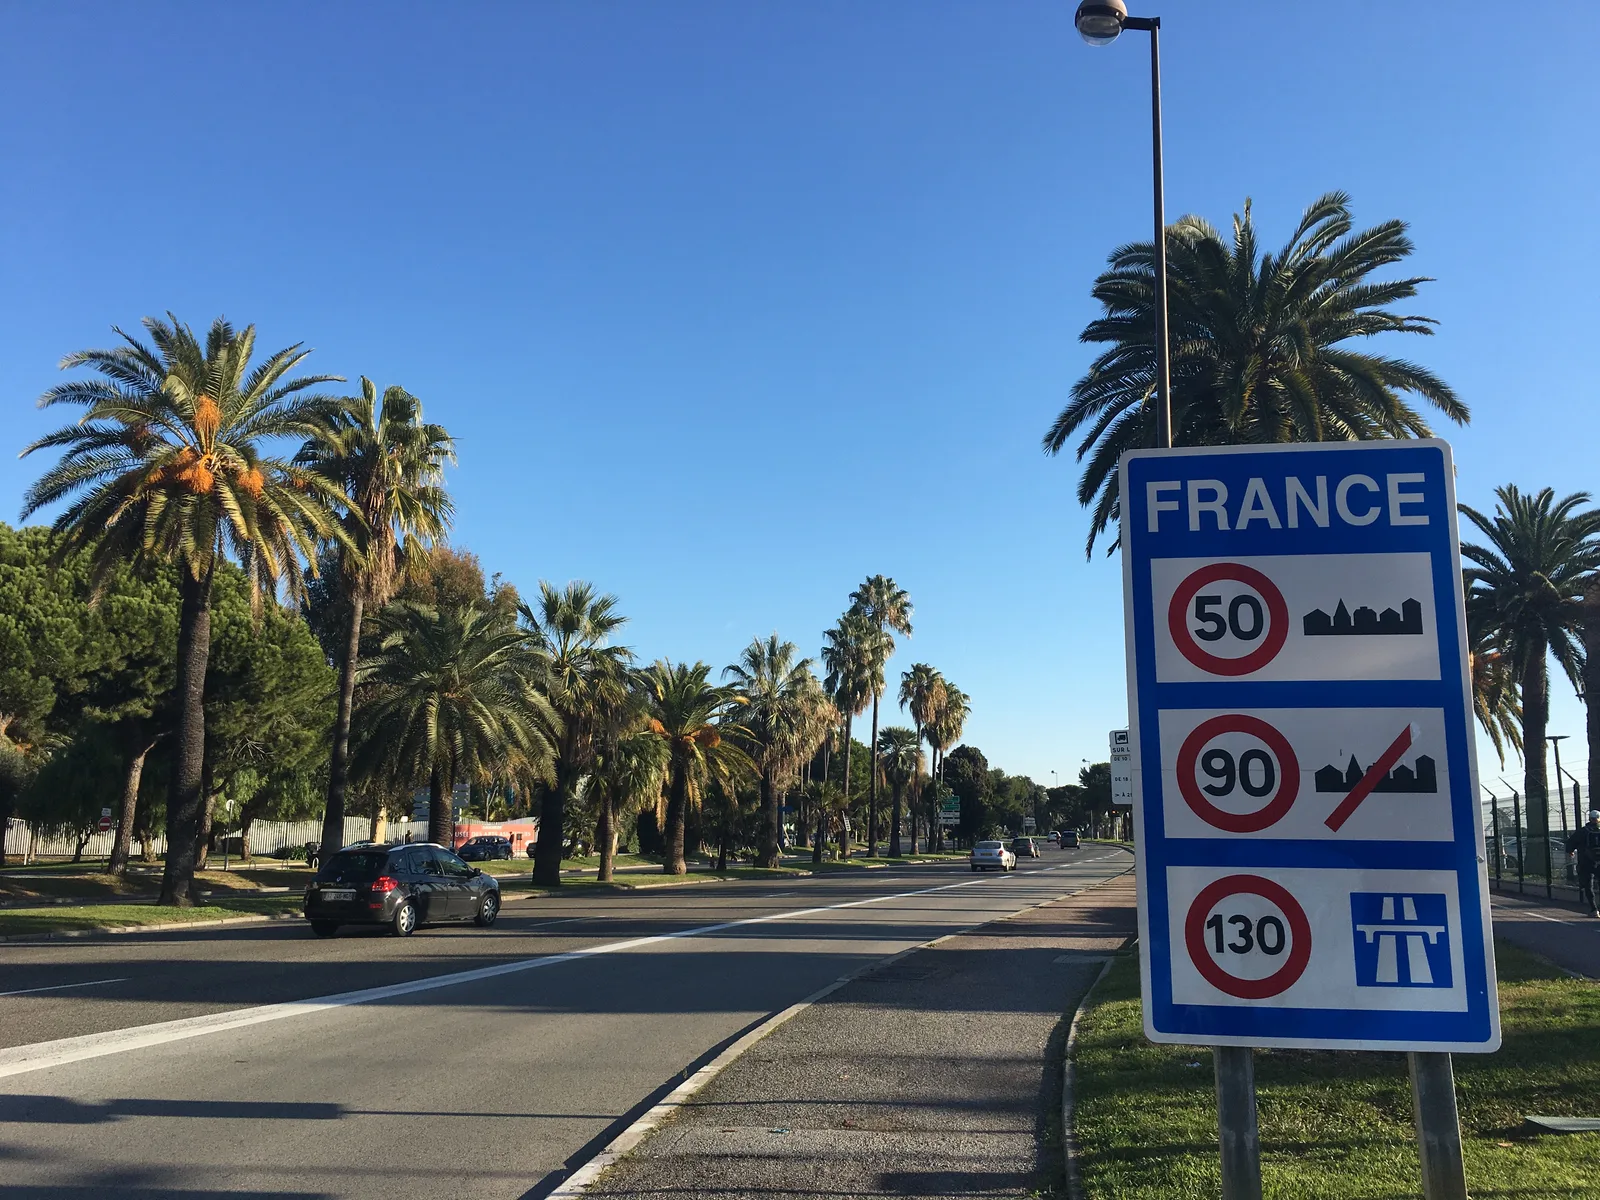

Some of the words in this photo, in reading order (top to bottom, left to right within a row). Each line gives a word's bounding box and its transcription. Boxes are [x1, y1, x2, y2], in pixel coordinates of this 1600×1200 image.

[1146, 472, 1430, 533] FRANCE
[1194, 594, 1264, 642] 50
[1200, 748, 1276, 798] 90
[1206, 913, 1286, 956] 130
